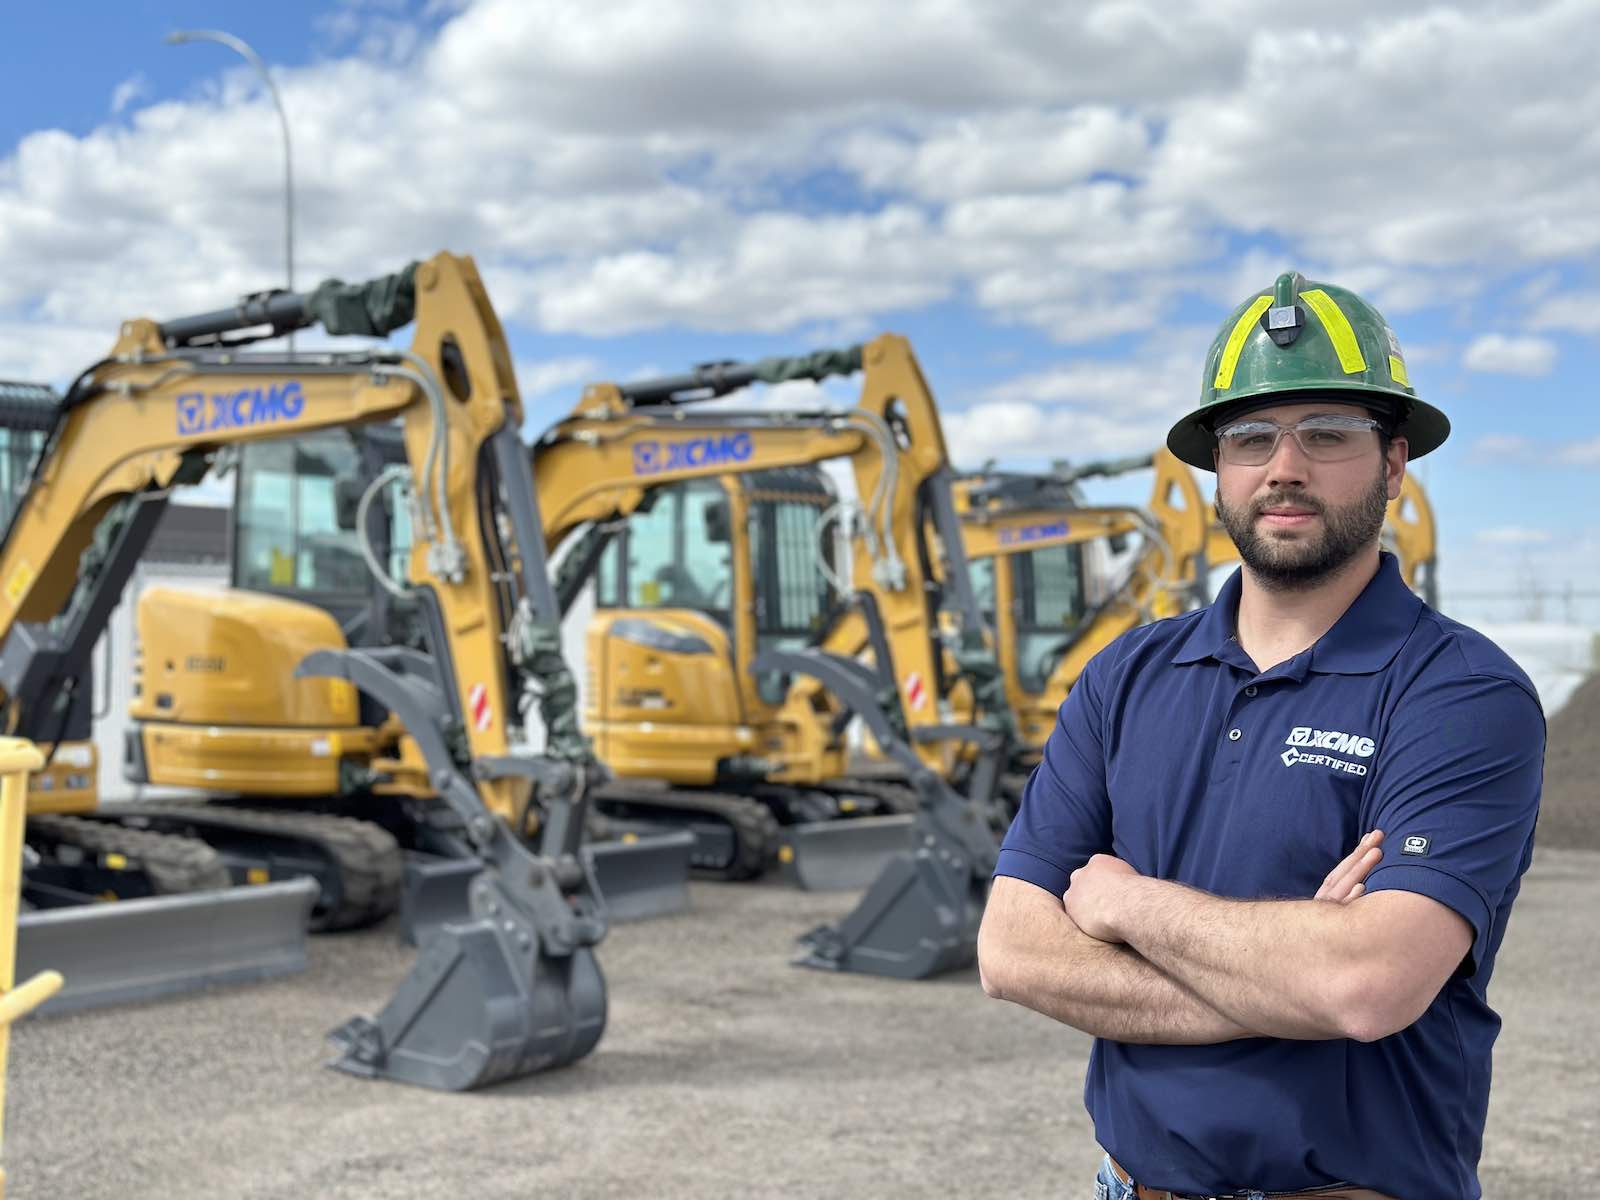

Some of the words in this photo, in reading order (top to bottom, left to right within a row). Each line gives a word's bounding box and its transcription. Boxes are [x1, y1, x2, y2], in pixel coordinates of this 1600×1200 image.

[211, 382, 305, 429] XCMG
[1308, 730, 1375, 757] XCMG
[1299, 753, 1367, 776] CERTIFIED
